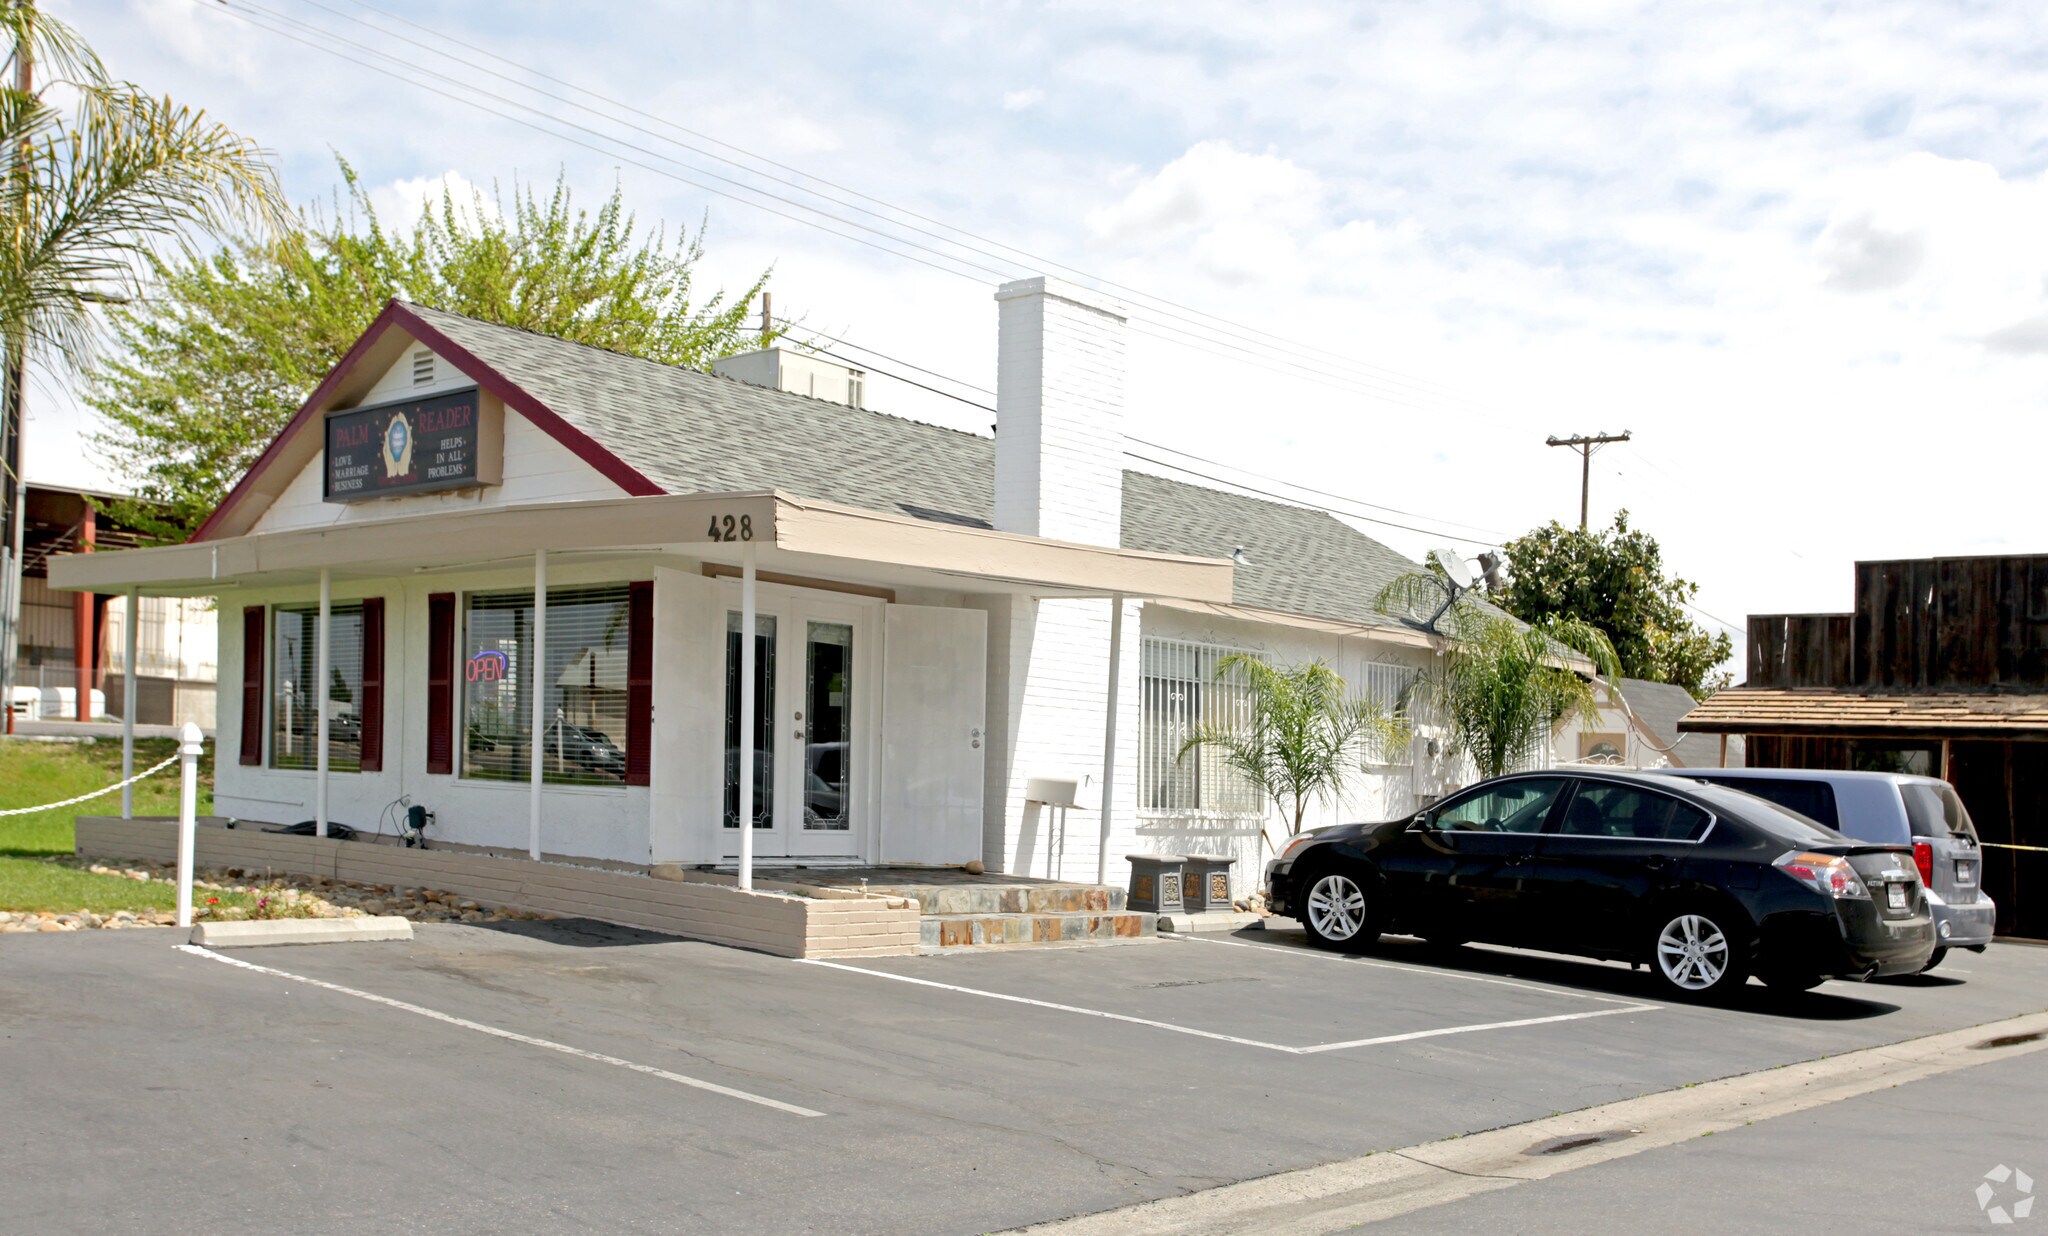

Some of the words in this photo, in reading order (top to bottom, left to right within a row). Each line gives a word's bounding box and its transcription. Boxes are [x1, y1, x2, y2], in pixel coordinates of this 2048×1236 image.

[336, 423, 369, 448] PALM
[418, 405, 471, 433] READER
[440, 437, 463, 450] HELPS
[335, 454, 352, 467] LOVE
[436, 453, 445, 463] IN
[447, 450, 463, 462] ALL
[335, 464, 369, 479] MARRIAGE
[427, 464, 463, 479] PROBLEMS
[334, 478, 363, 492] BUSINESS
[708, 514, 753, 542] 428
[466, 657, 503, 682] OPEN
